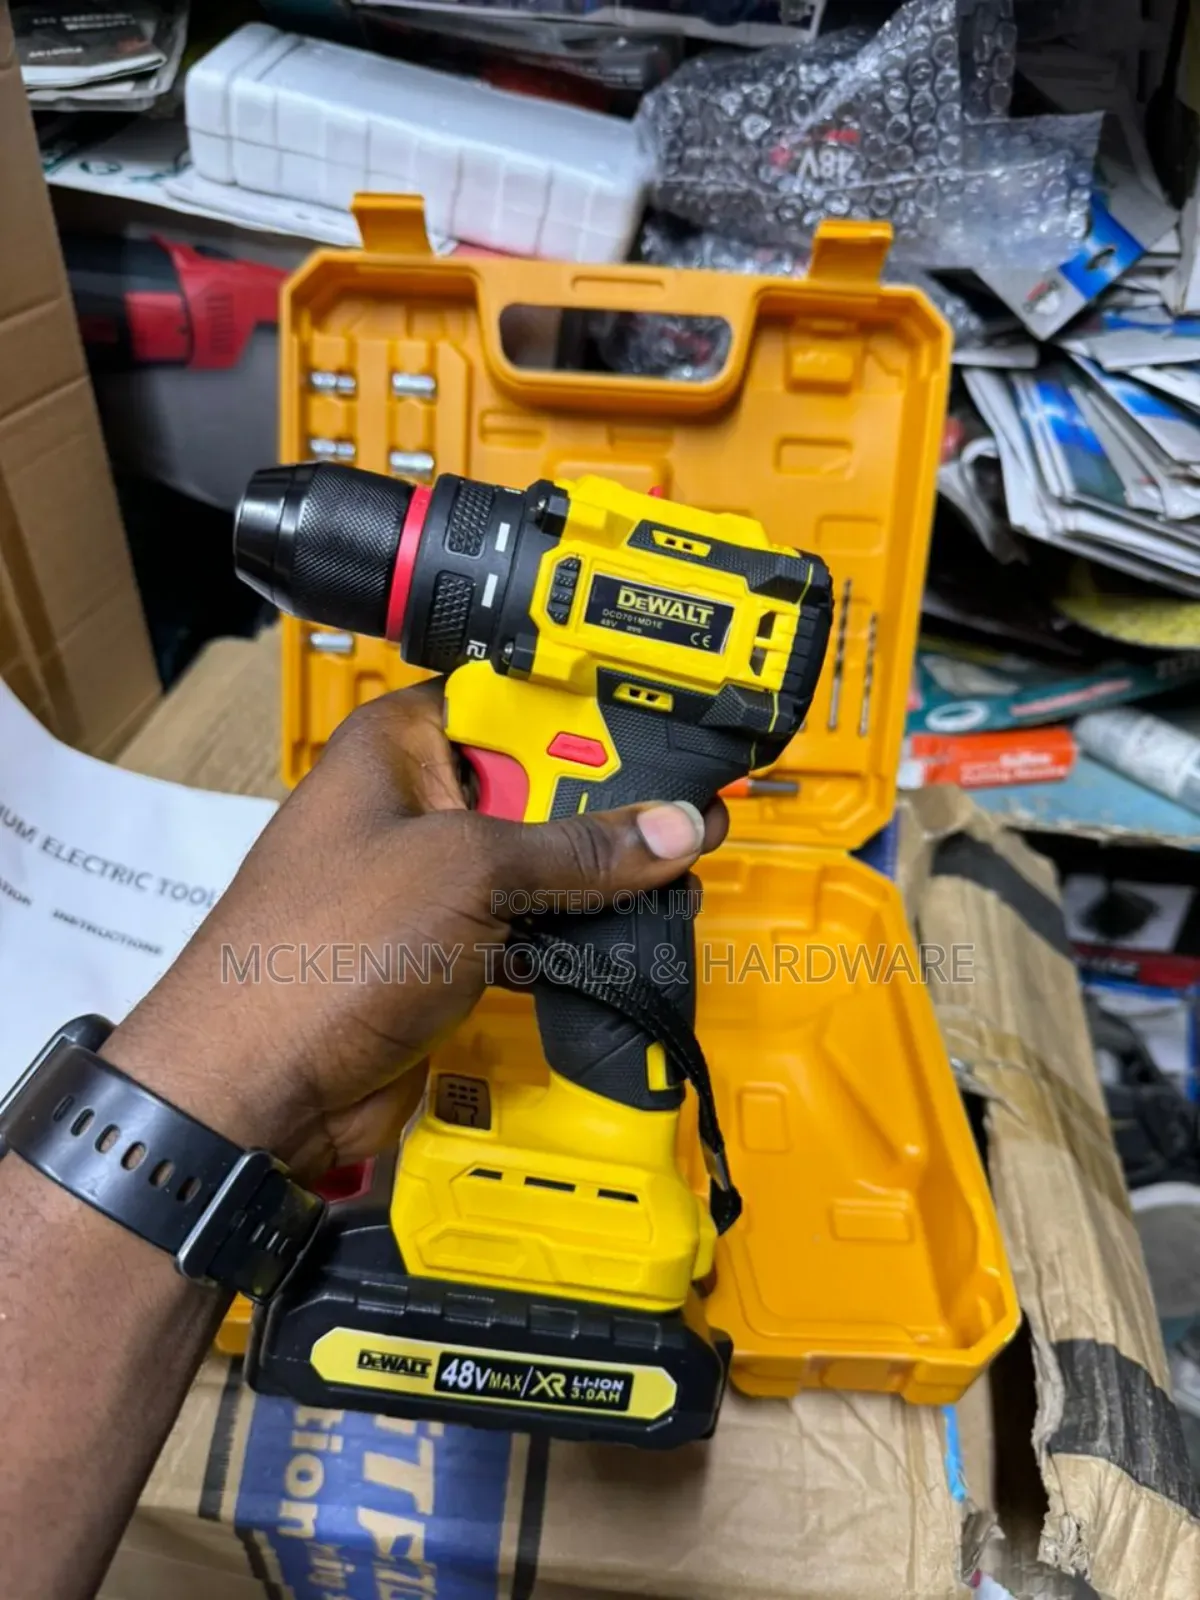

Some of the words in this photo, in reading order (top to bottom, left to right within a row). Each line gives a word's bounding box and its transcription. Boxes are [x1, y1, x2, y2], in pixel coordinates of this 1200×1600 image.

[796, 147, 856, 188] 48V
[617, 586, 714, 628] DEWALT
[41, 834, 153, 892] ELECTRIC
[357, 1349, 432, 1379] DEWALT
[571, 1375, 624, 1391] LI-ION
[571, 1387, 621, 1403] 3.0AH
